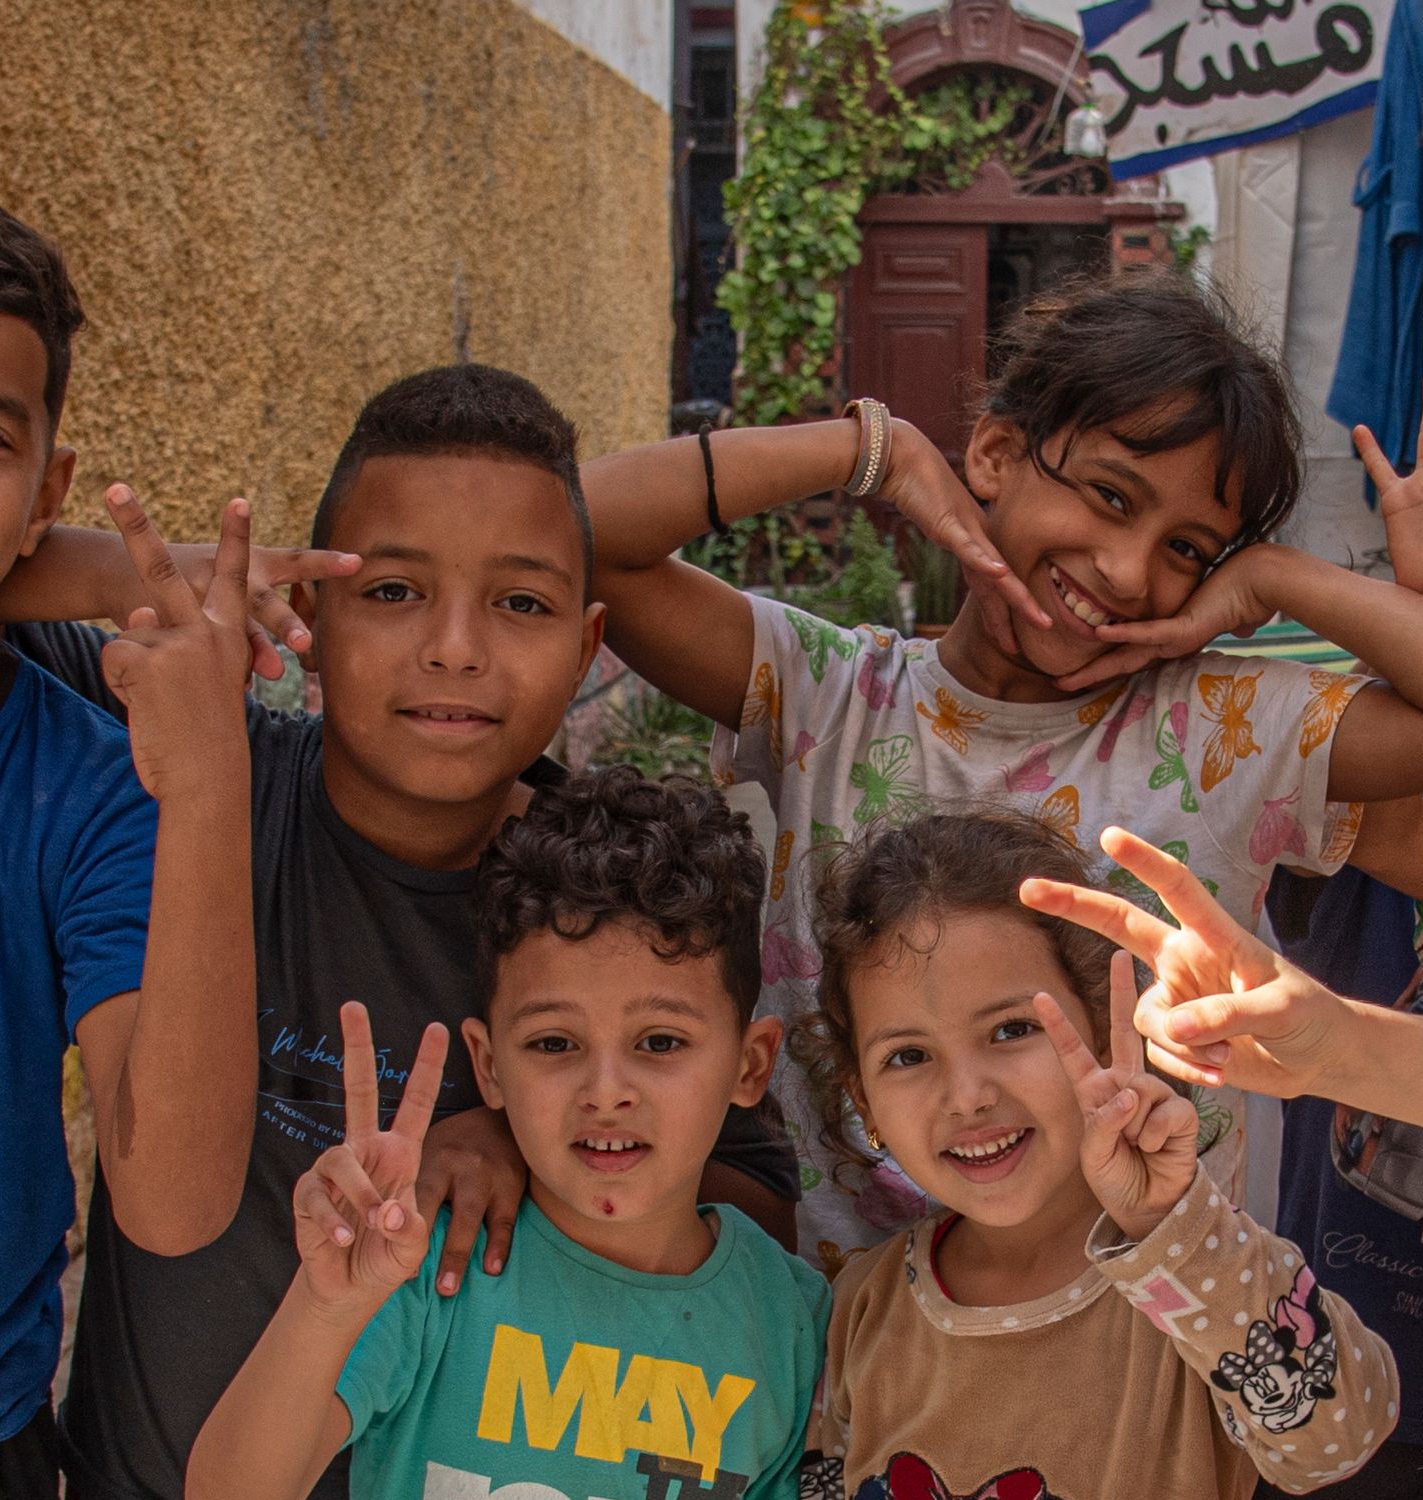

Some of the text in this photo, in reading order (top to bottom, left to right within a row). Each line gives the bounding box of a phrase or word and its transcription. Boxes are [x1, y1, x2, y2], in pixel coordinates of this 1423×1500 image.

[1087, 4, 1375, 146] مسجد
[1323, 1232, 1423, 1277] Classic
[477, 1323, 756, 1482] MAY
